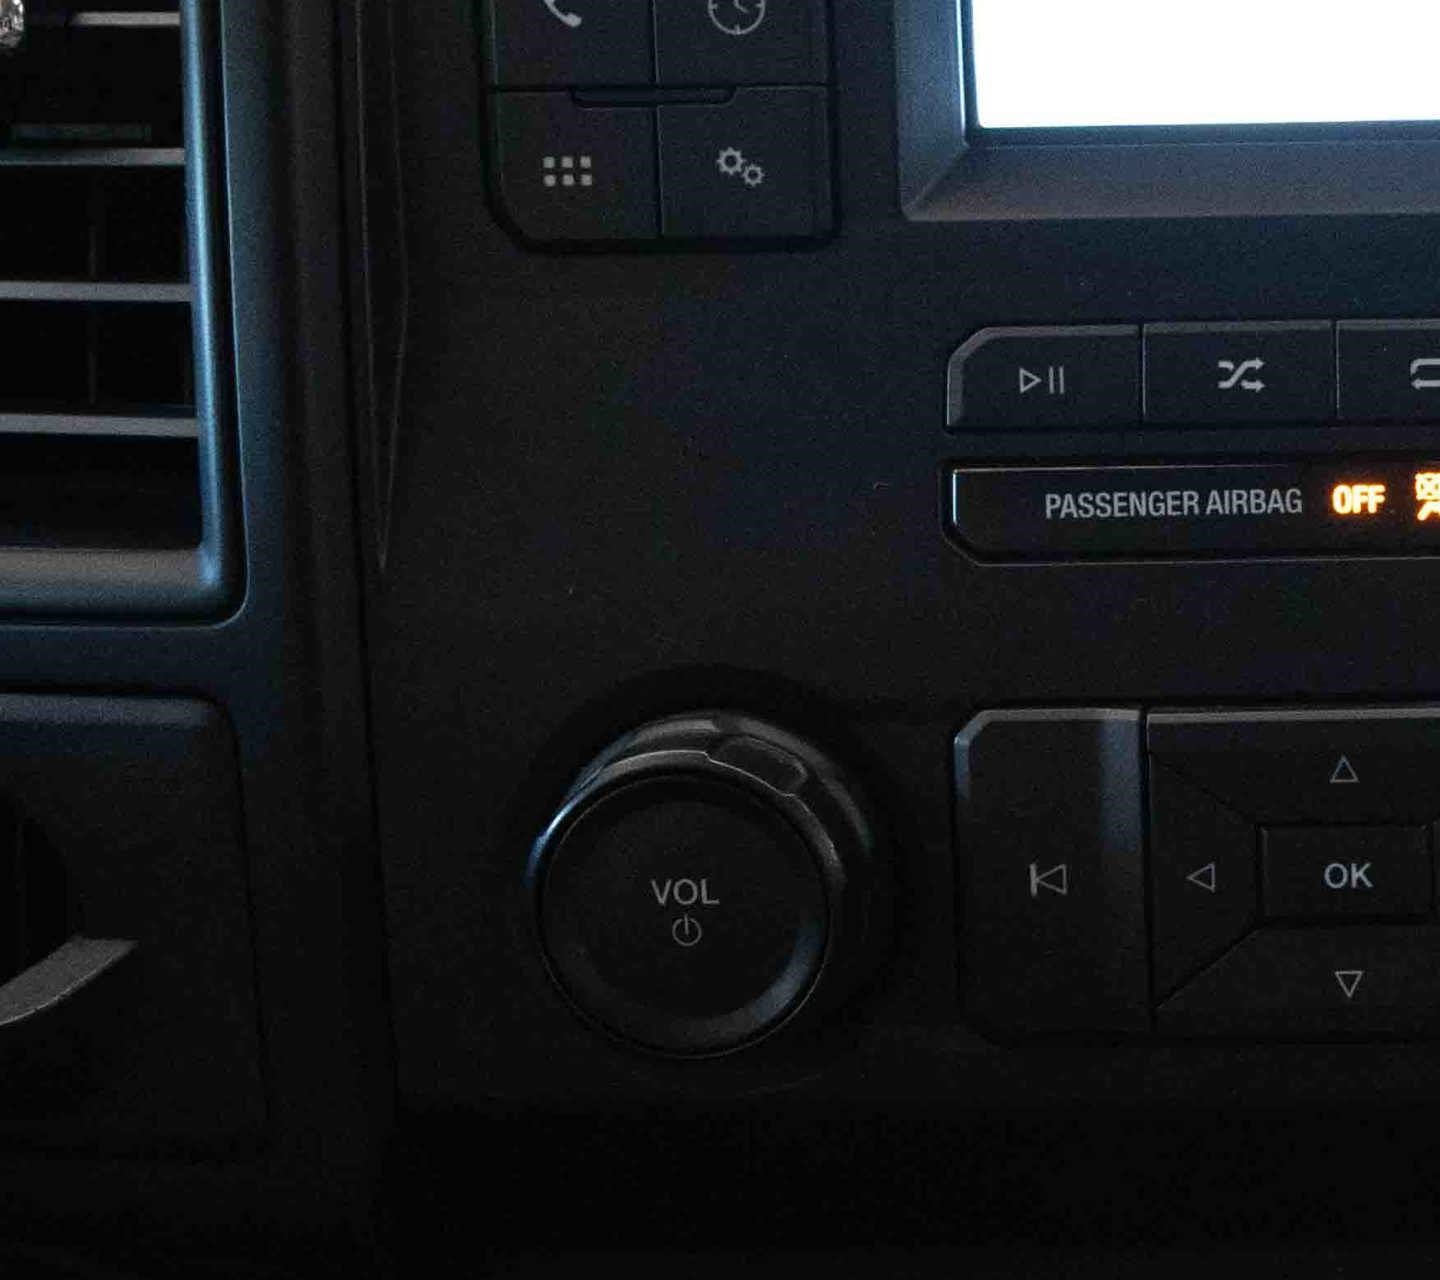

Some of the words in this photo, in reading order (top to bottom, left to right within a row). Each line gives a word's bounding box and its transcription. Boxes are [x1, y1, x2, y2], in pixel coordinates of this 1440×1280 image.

[1044, 490, 1200, 520] PASSENGER
[1205, 488, 1303, 516] AIRBAG
[1330, 483, 1387, 516] OFF
[1319, 861, 1373, 889] OK
[651, 877, 721, 906] VOL
